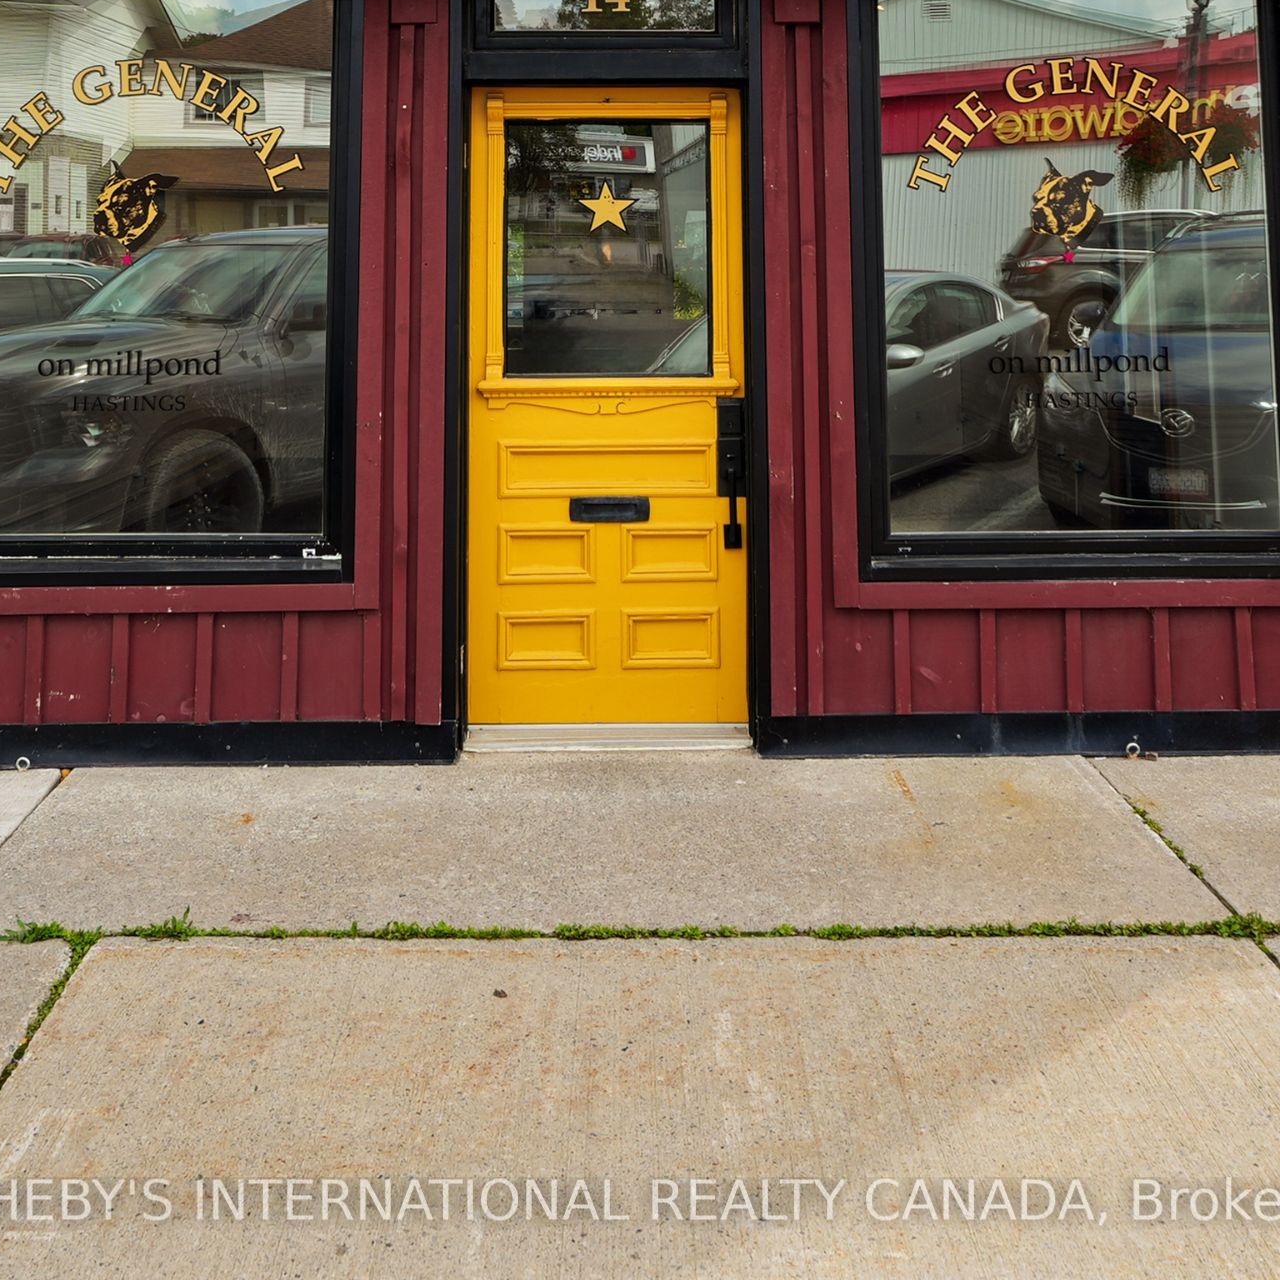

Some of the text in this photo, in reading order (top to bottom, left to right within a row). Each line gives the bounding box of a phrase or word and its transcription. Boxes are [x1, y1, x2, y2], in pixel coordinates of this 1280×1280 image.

[72, 57, 305, 193] GENERAL
[907, 56, 1243, 195] THE GENERAL
[37, 349, 223, 386] on millpond
[988, 346, 1173, 378] on millpond
[71, 394, 187, 413] HASTINGS
[1024, 390, 1140, 410] HASTINGS
